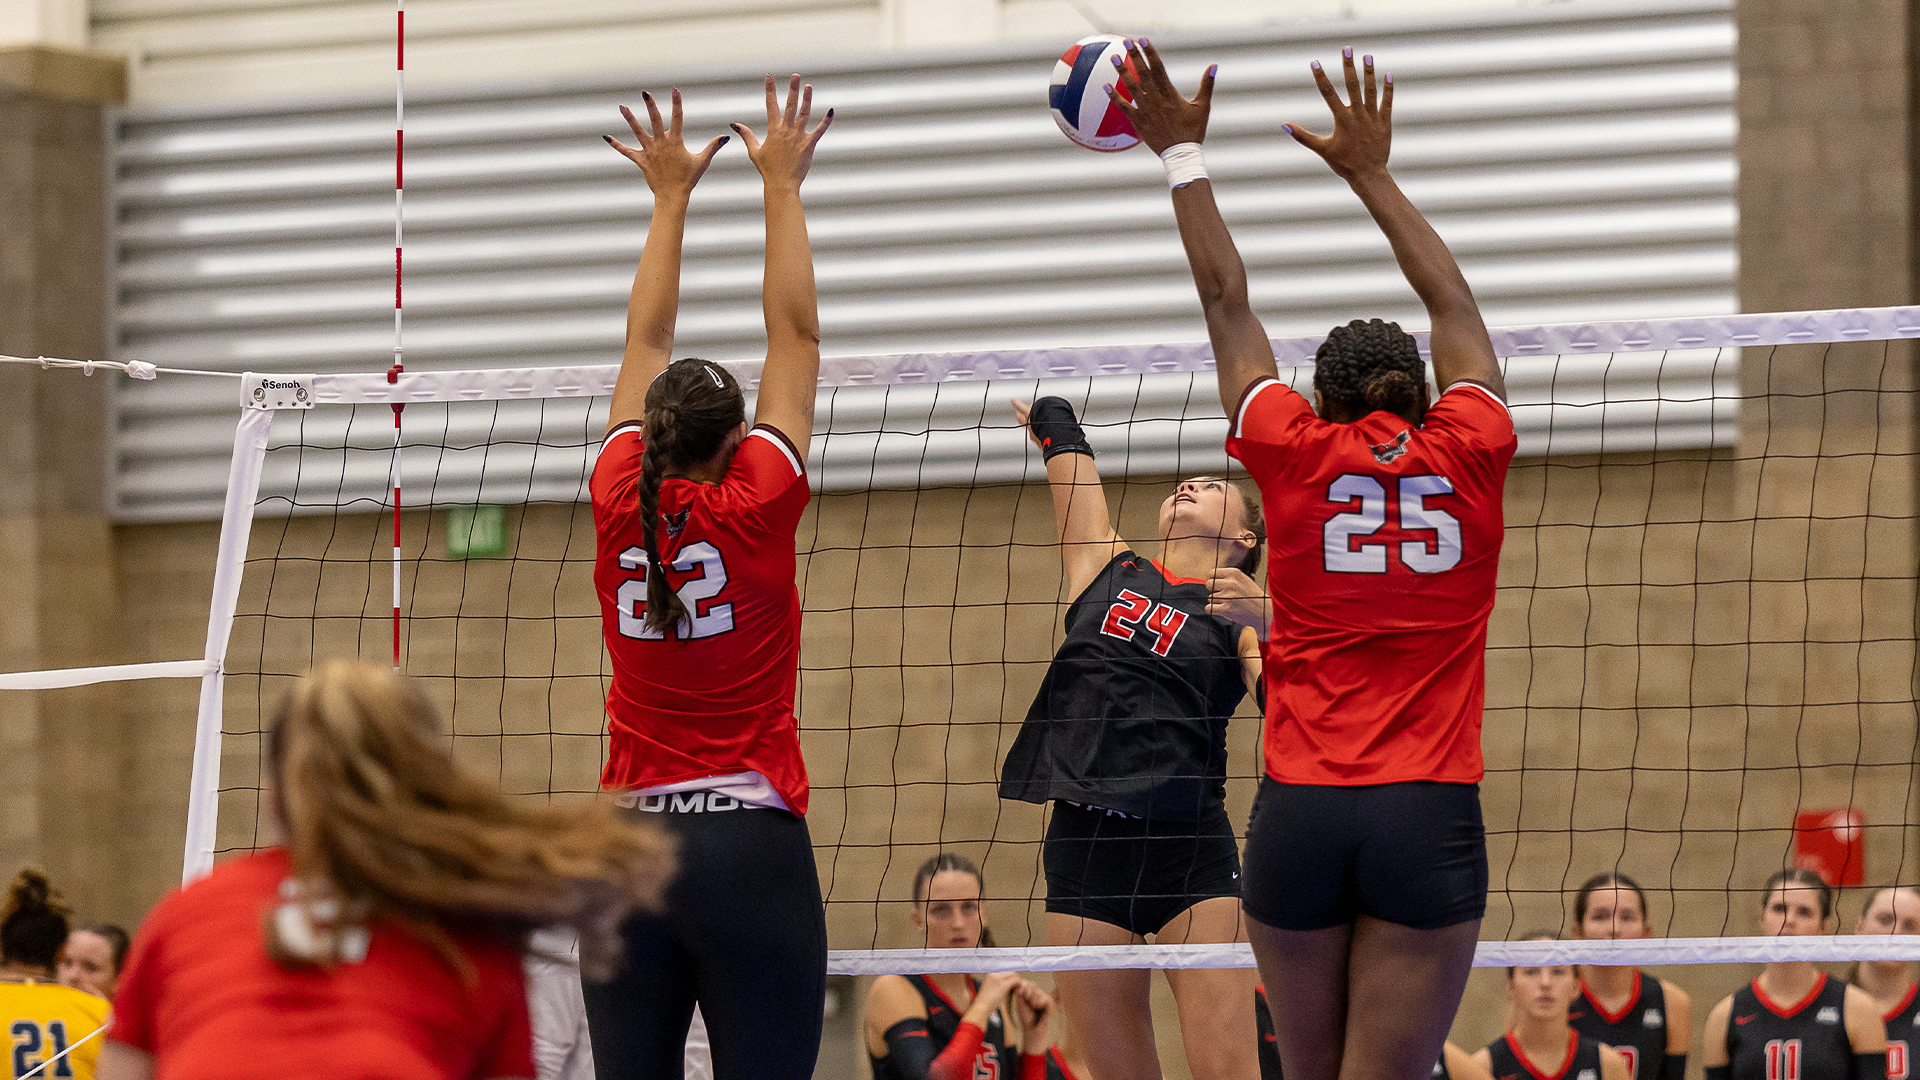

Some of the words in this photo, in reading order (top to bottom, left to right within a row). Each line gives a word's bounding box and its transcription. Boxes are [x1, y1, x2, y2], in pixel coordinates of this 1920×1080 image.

[269, 380, 300, 389] Senoh
[1322, 472, 1463, 575] 25
[616, 539, 736, 642] 22
[1100, 587, 1190, 657] 24
[10, 1020, 74, 1078] 21
[1763, 1038, 1803, 1080] 11
